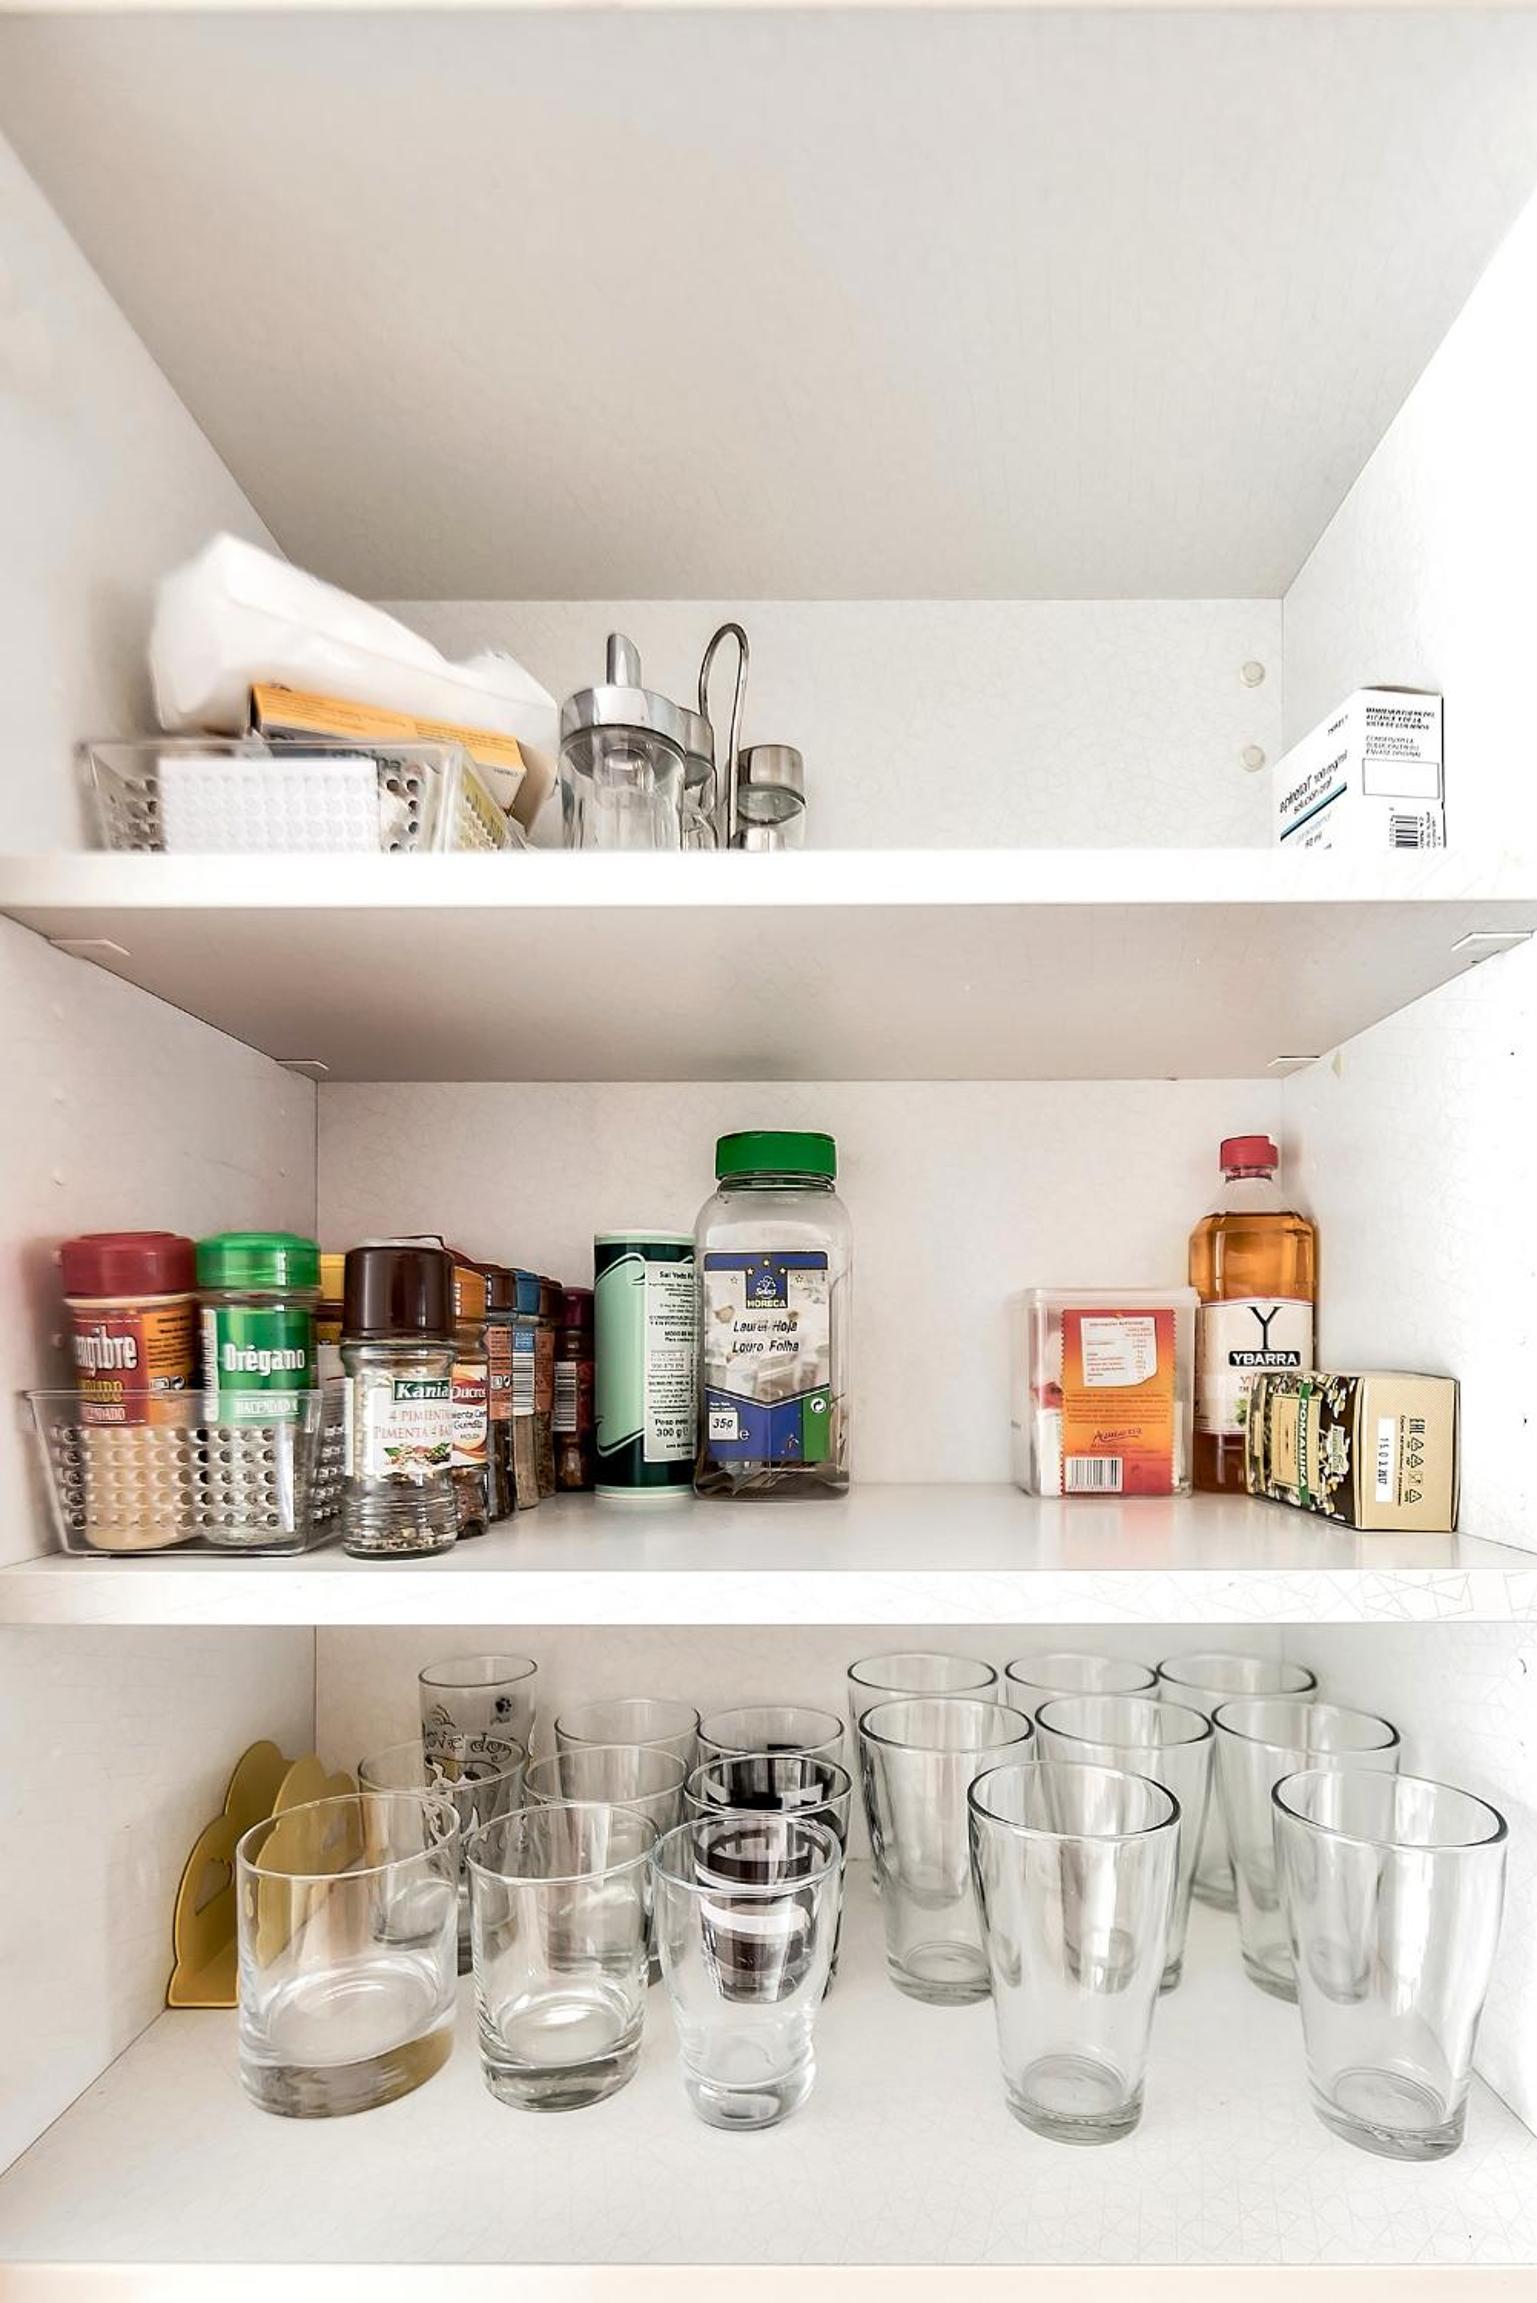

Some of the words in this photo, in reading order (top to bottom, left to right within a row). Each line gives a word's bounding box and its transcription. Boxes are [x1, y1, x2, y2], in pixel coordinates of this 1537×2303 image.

[747, 1299, 787, 1308] HORECA
[772, 1320, 798, 1334] Hoja
[1247, 1305, 1283, 1350] Y
[732, 1341, 764, 1353] Louro
[769, 1340, 799, 1353] Folha
[223, 1344, 306, 1376] Orégano
[1232, 1352, 1298, 1366] YBARRA
[396, 1381, 450, 1399] Kania
[656, 1428, 674, 1437] 300
[1299, 1398, 1308, 1488] РОМАШКА
